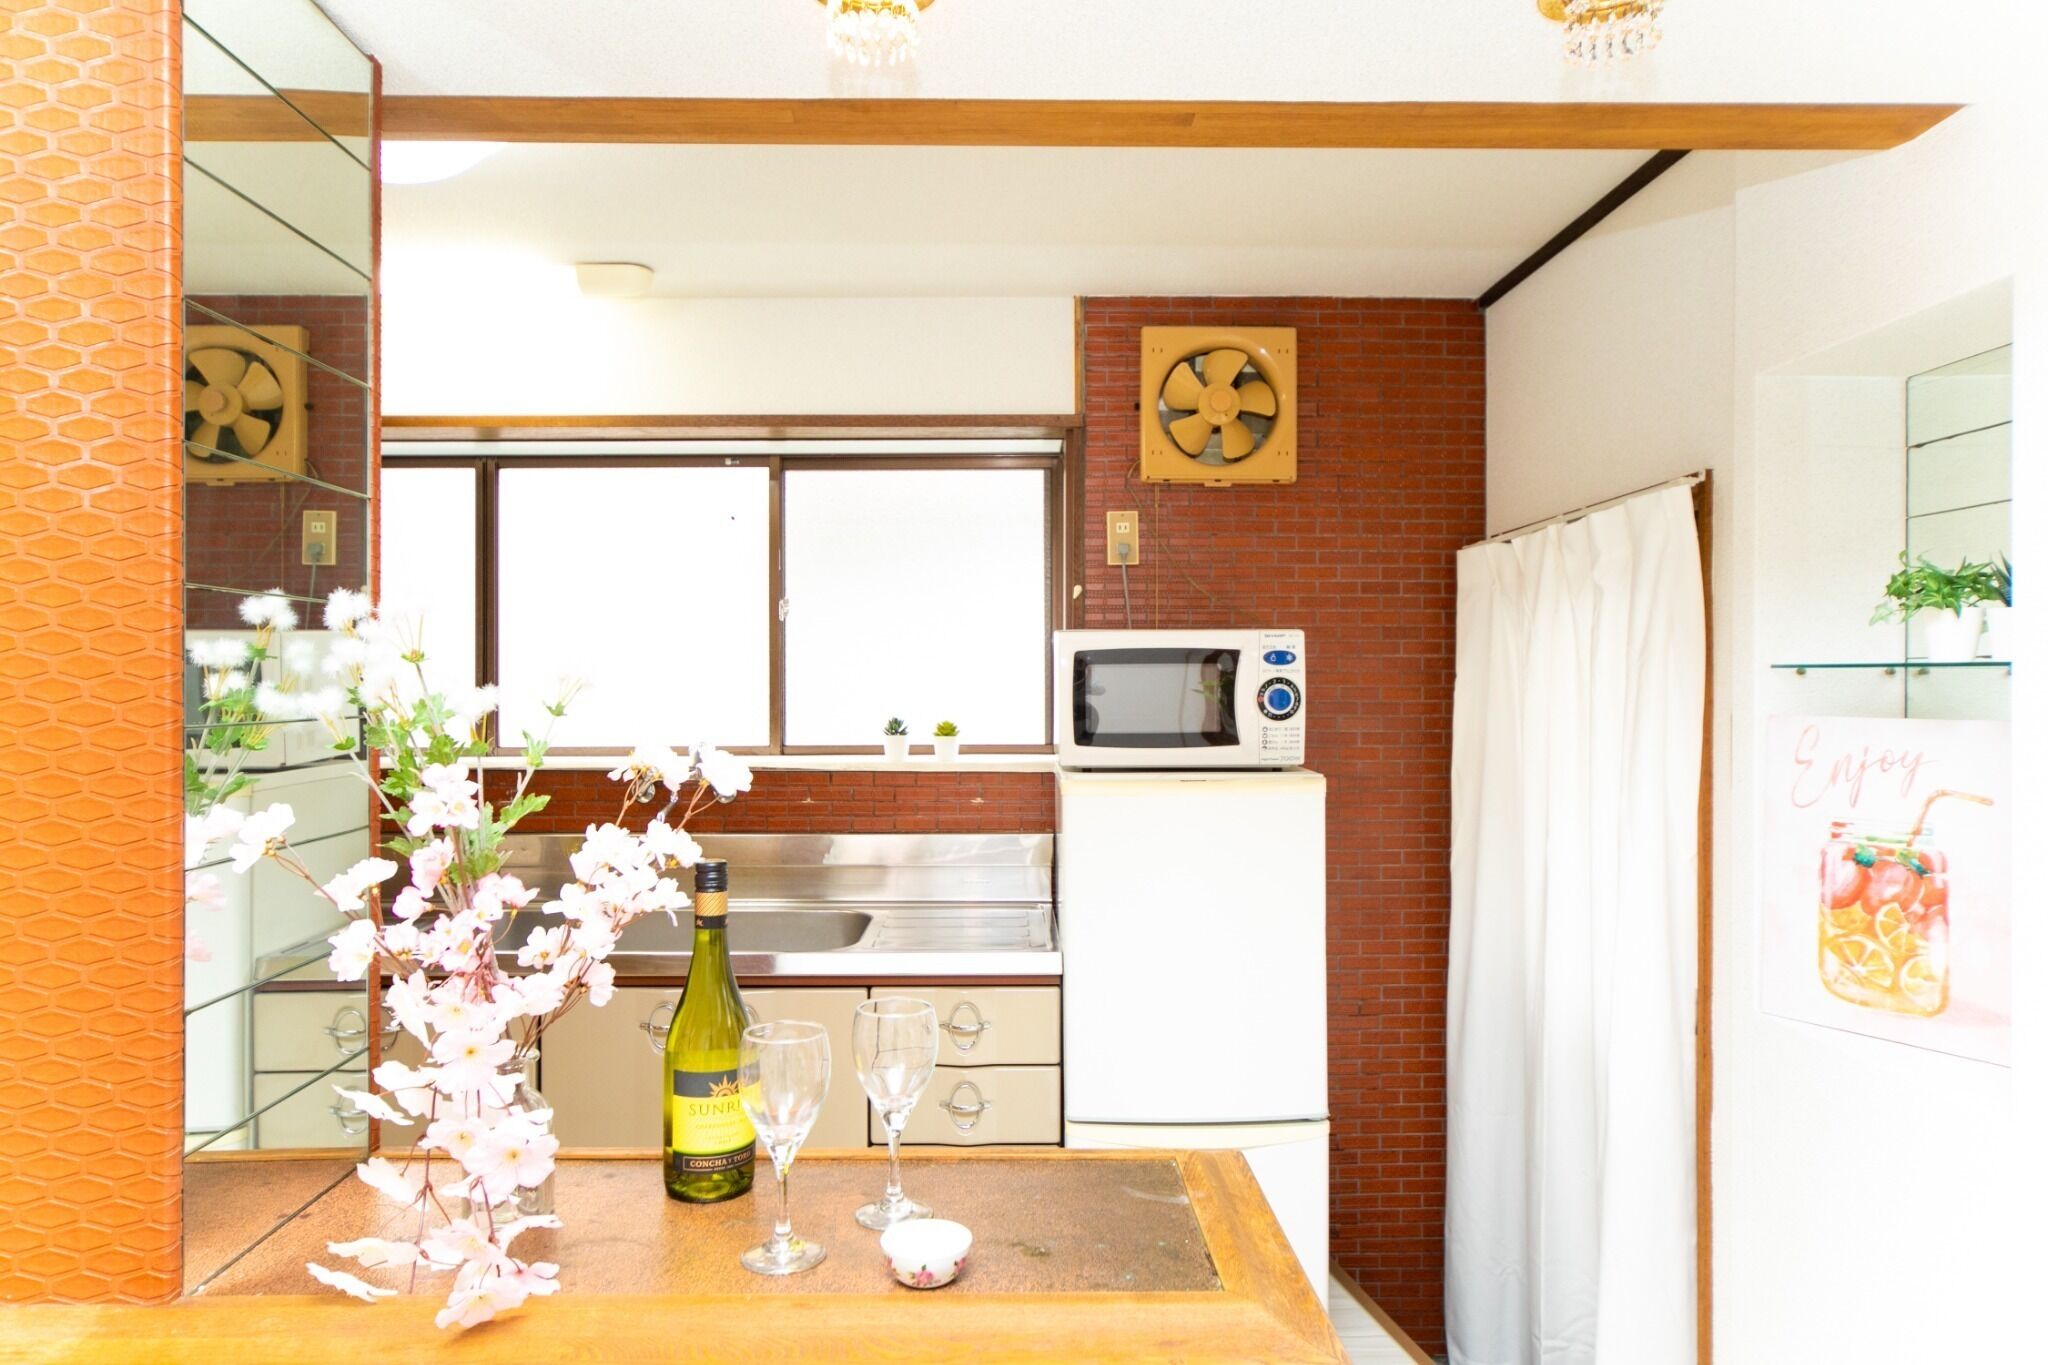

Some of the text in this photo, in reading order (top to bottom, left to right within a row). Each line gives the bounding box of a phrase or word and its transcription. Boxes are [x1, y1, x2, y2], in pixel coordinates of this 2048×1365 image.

[1791, 724, 1938, 809] Enjoy
[688, 1099, 741, 1116] SUNRI
[690, 1158, 727, 1168] CONCHA
